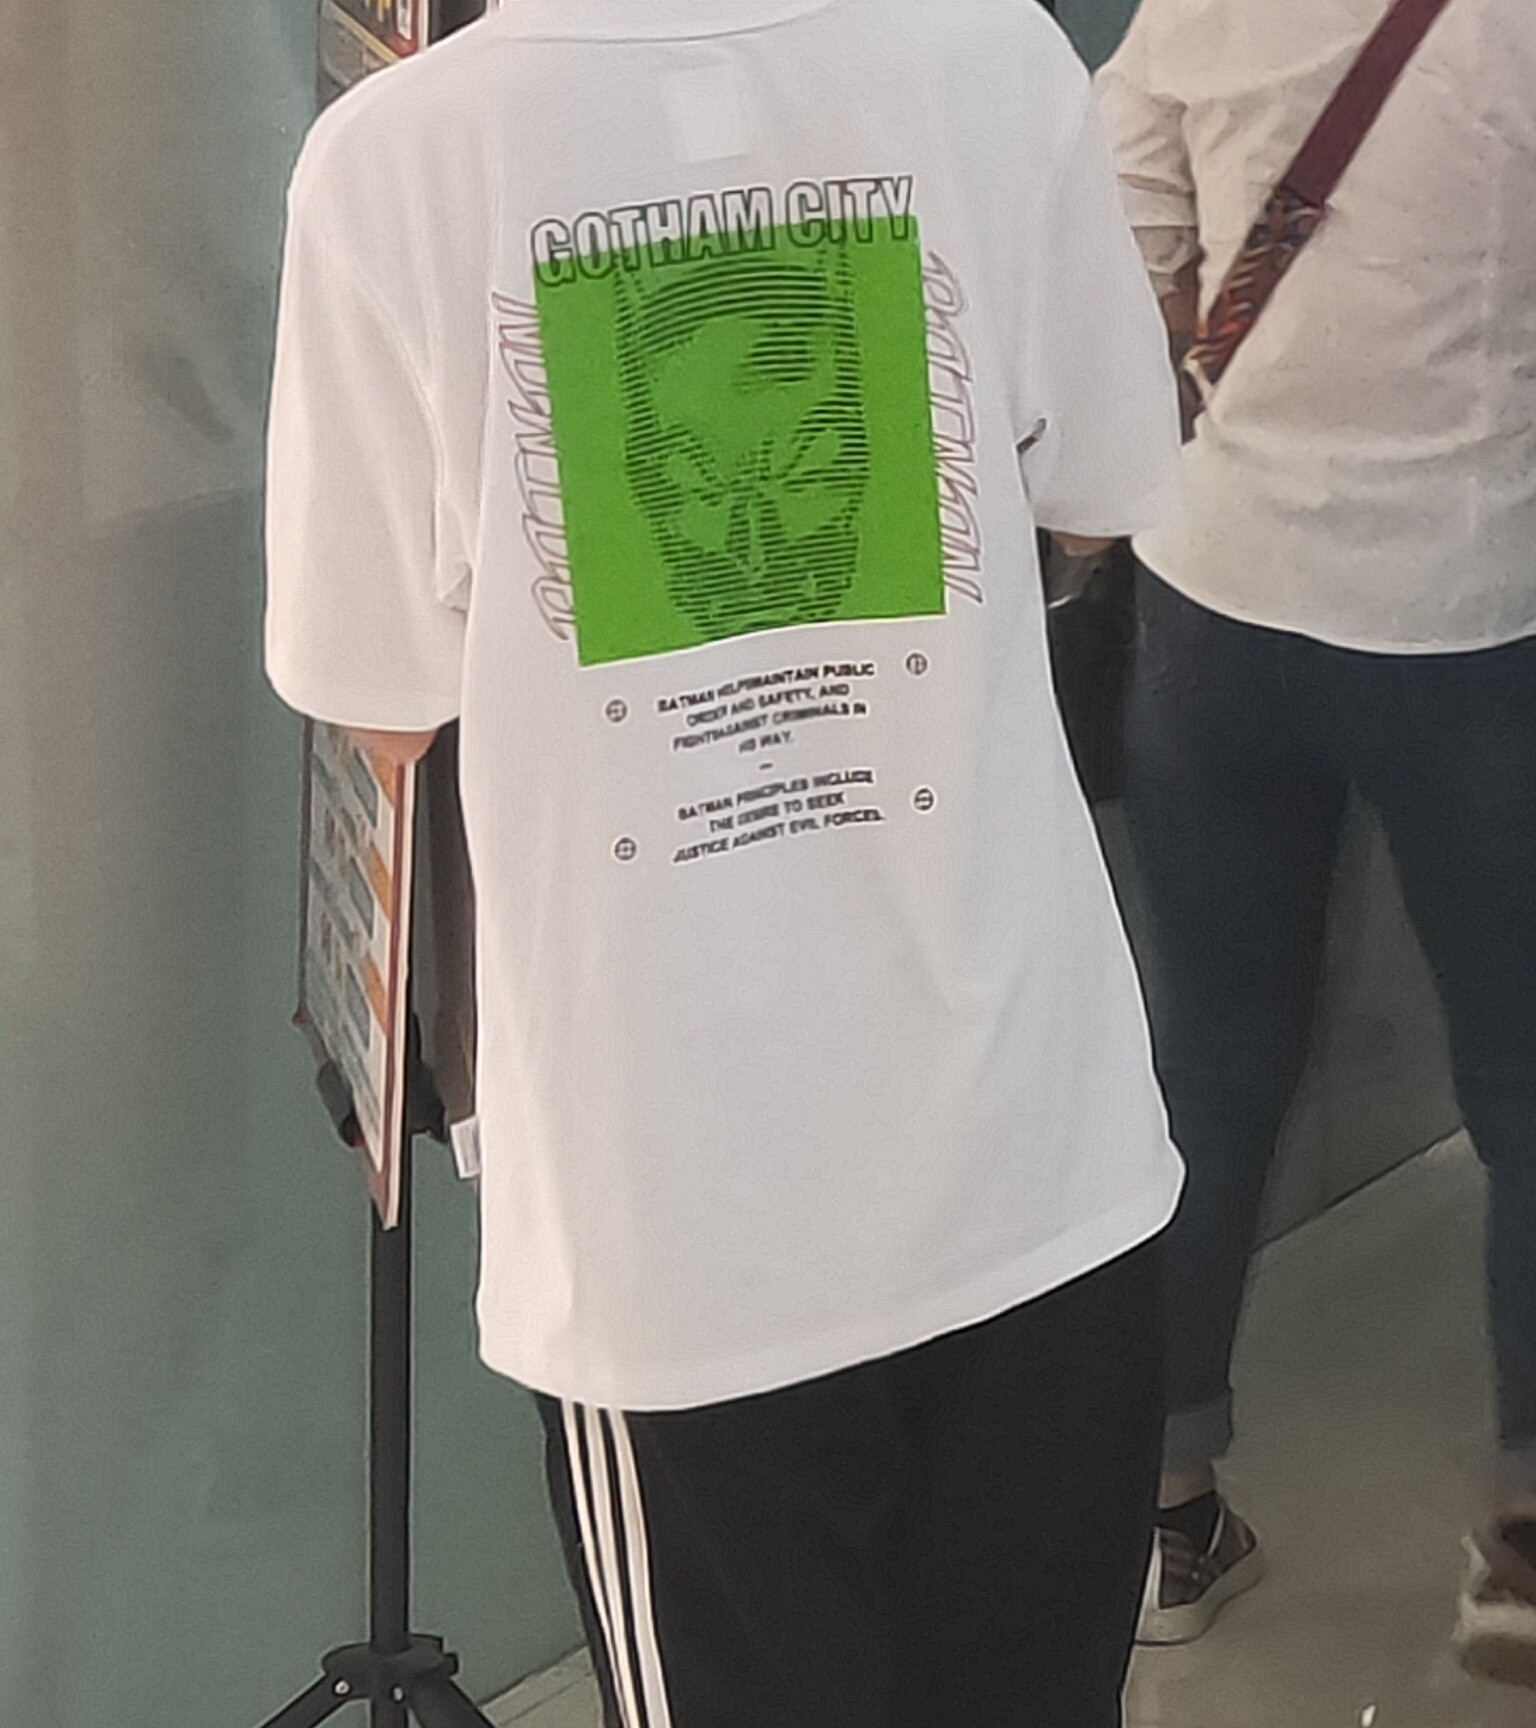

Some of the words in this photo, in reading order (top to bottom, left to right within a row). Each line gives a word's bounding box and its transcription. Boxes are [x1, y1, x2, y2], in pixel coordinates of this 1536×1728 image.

[530, 186, 775, 288] GOTHAM
[785, 174, 914, 249] CITY
[822, 662, 875, 678] PUBLIC
[818, 682, 850, 699] AND
[677, 796, 734, 821] BATMAN
[709, 815, 734, 833] THE
[784, 799, 803, 814] TO
[673, 836, 730, 863] JUSTICE
[732, 822, 786, 849] AGAINST
[788, 818, 820, 835] EVIL
